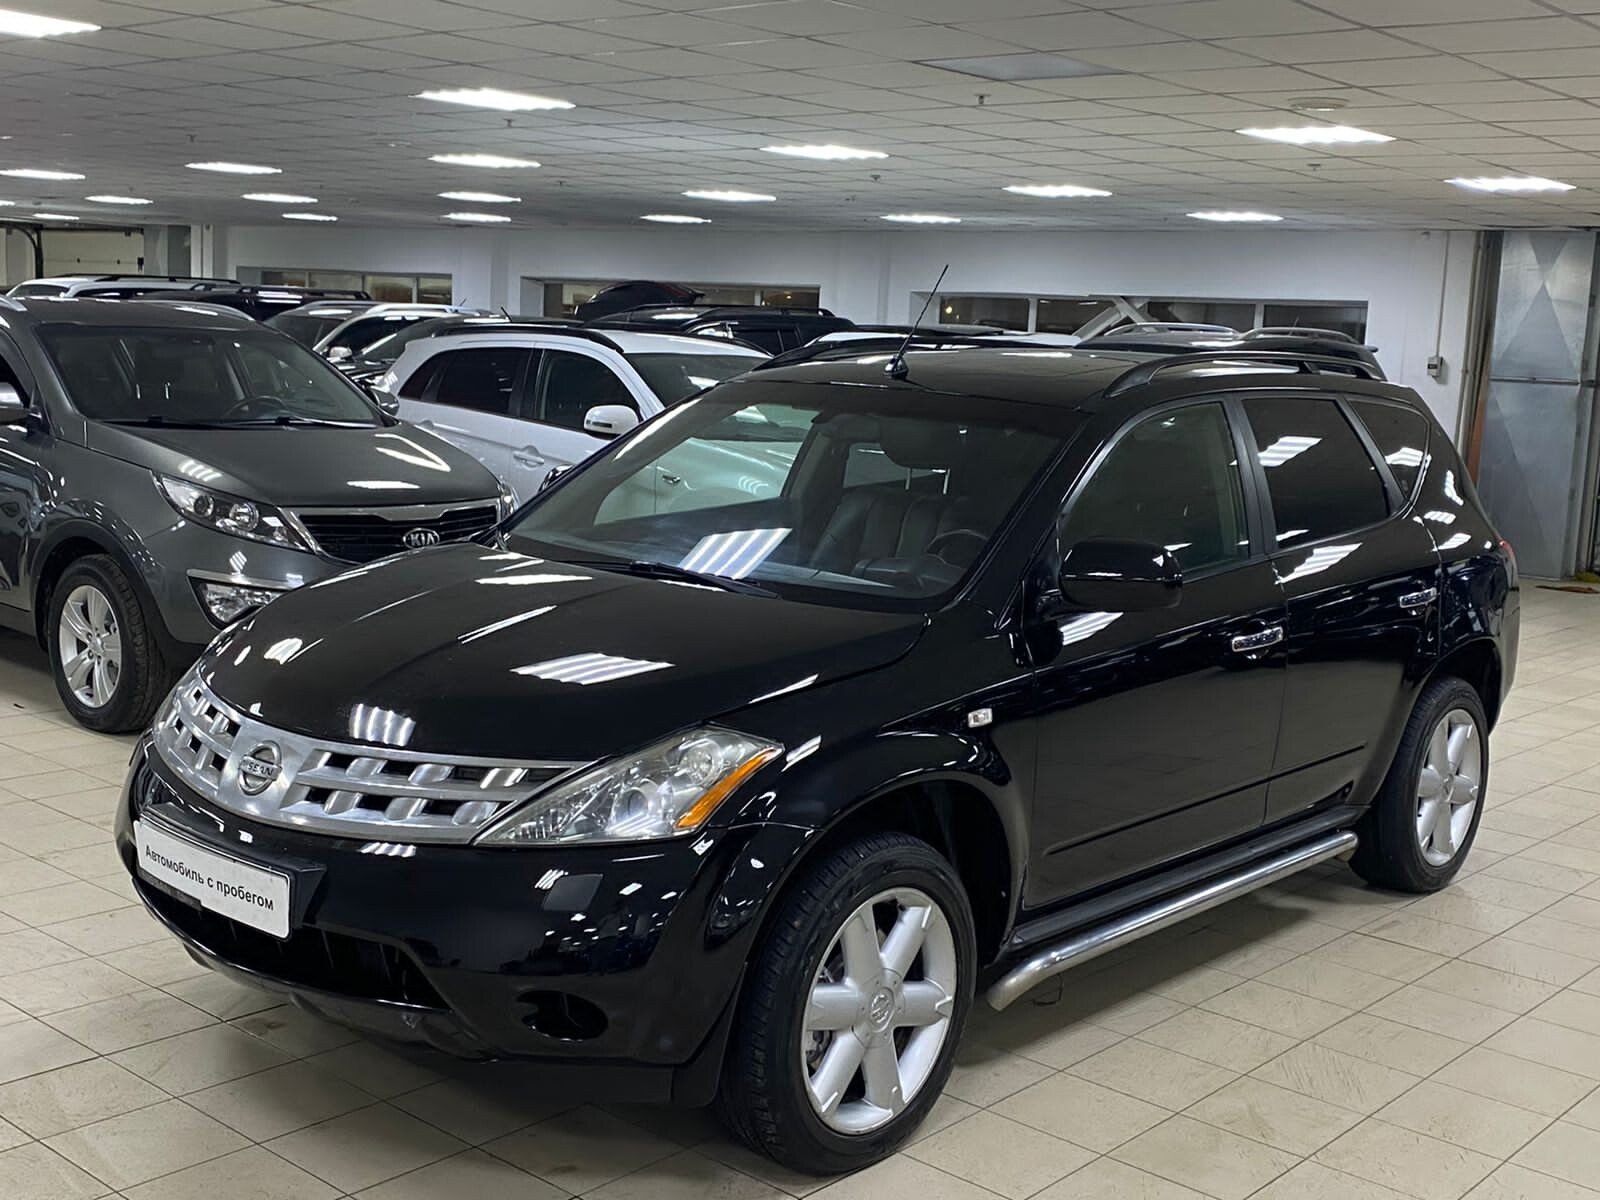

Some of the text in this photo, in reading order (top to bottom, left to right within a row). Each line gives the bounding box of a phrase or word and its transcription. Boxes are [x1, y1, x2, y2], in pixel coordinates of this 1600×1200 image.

[410, 532, 436, 546] KIA
[145, 844, 274, 911] Автомобиль с пробегом
